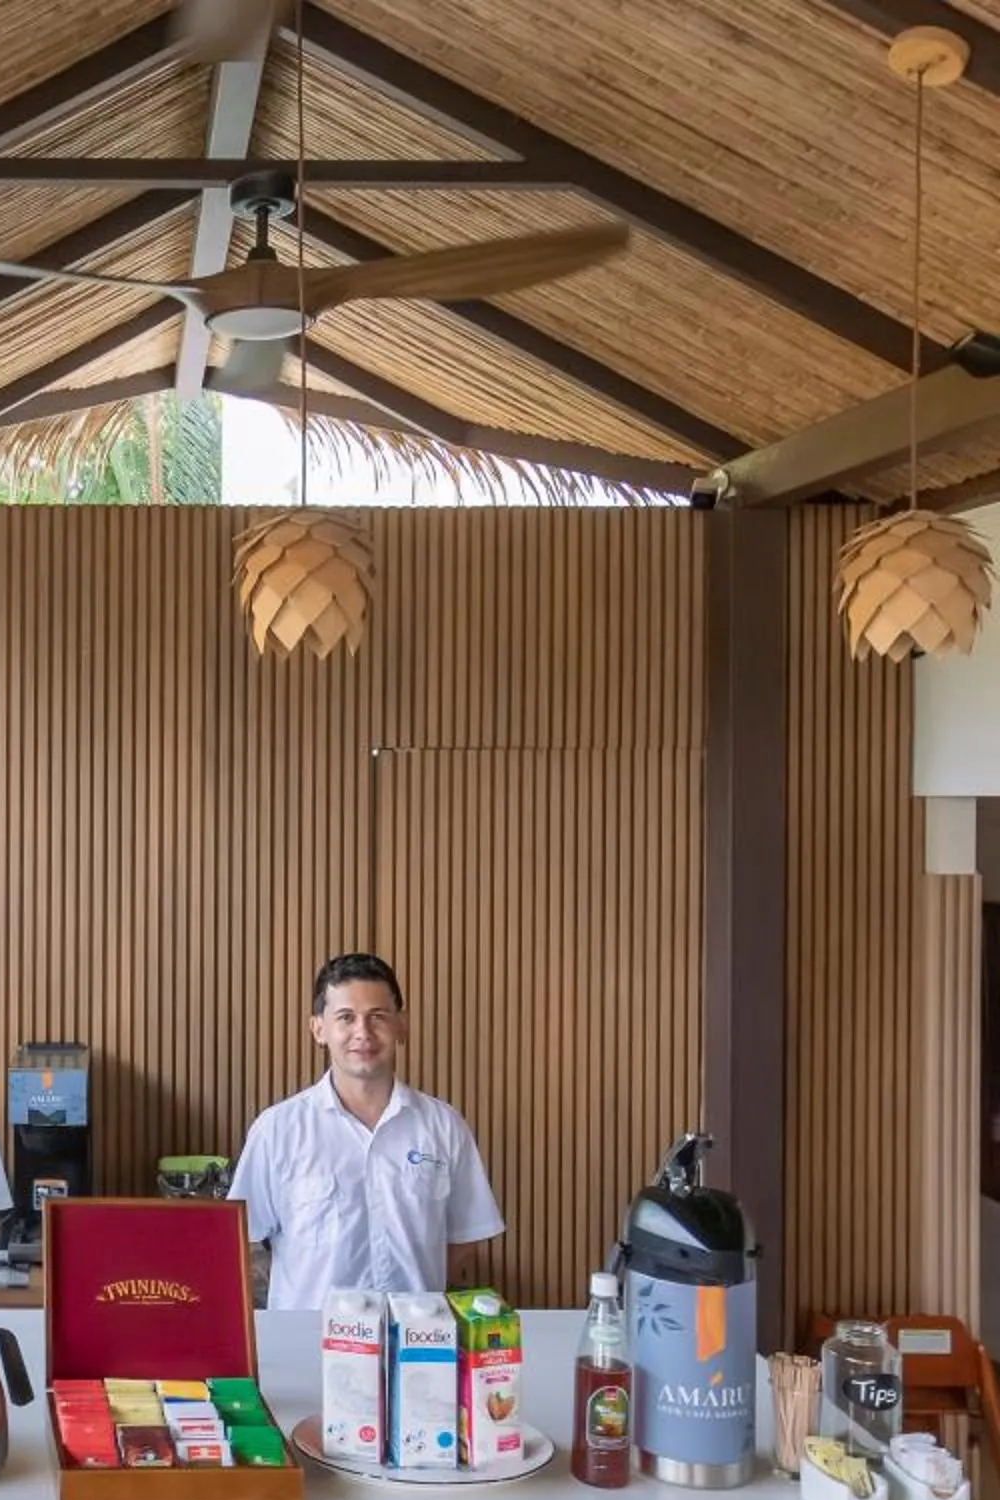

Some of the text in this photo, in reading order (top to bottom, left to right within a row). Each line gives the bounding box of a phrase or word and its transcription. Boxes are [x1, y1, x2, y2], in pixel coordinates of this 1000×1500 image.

[103, 1279, 192, 1301] TWININGS
[327, 1318, 374, 1340] foodie
[851, 1379, 897, 1408] Tips
